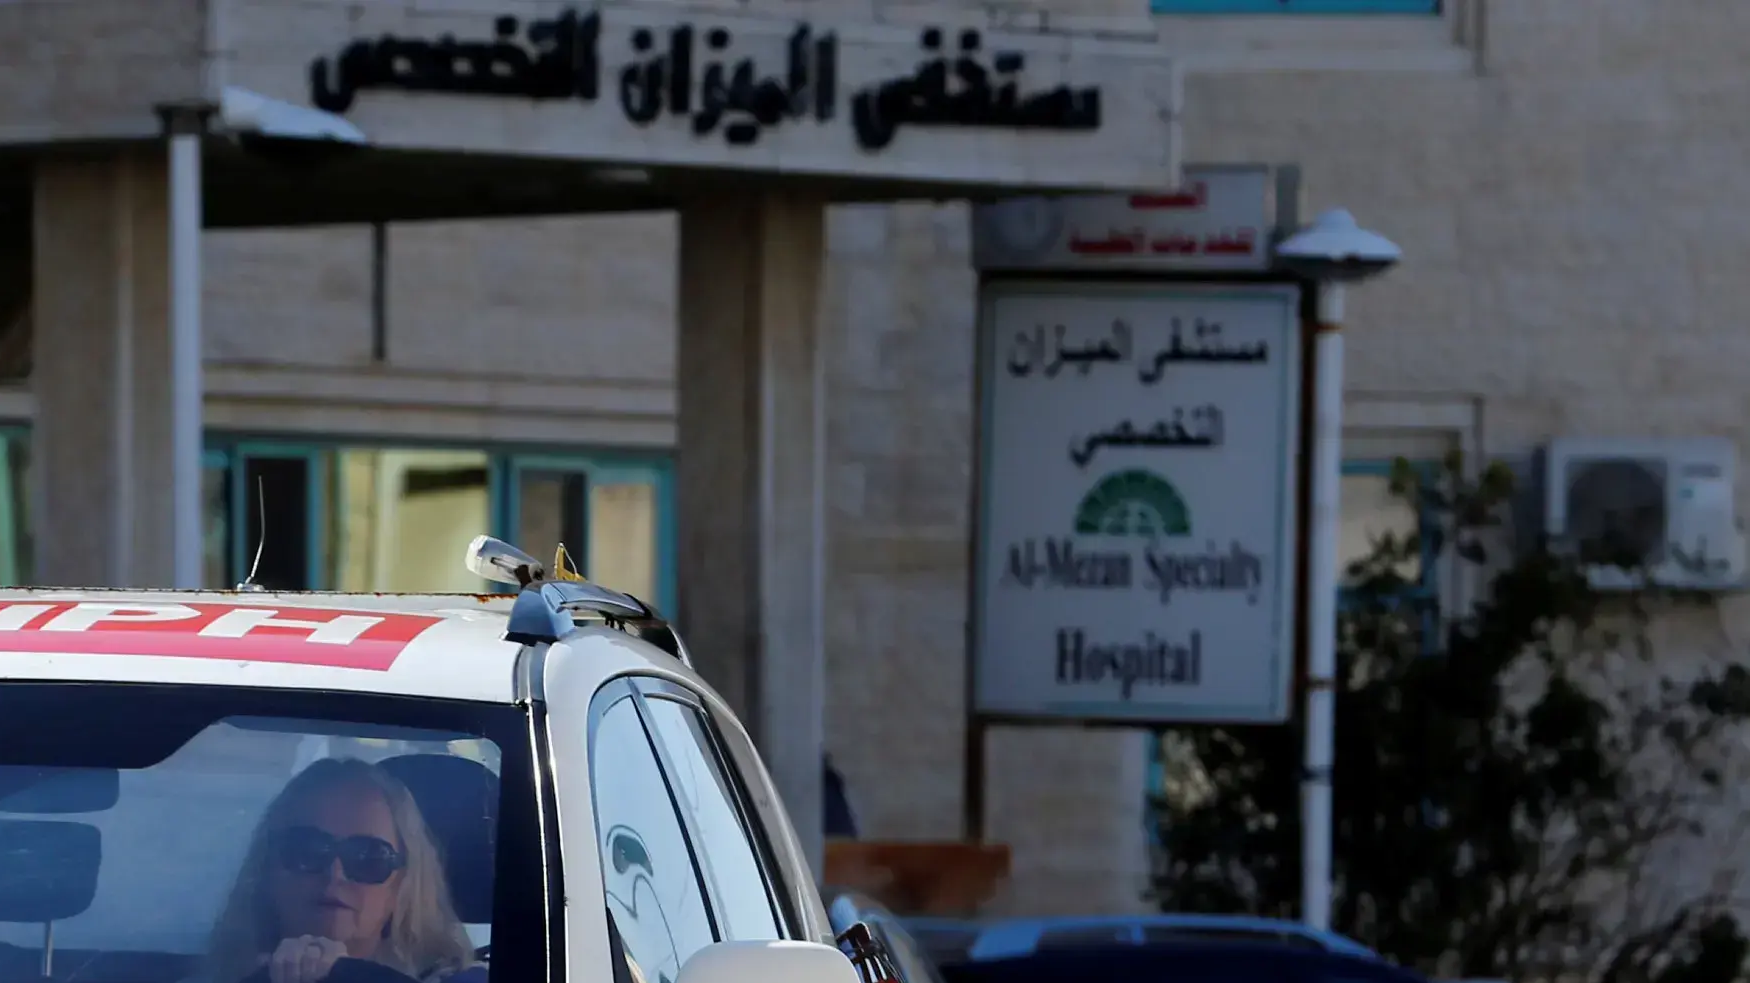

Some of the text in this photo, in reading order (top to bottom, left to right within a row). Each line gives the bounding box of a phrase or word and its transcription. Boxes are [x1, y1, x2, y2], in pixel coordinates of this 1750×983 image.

[619, 22, 836, 146] الميزان
[1007, 317, 1268, 384] مستشفى الميزان
[1143, 540, 1263, 604] Specialty
[1056, 628, 1201, 699] Hospital
